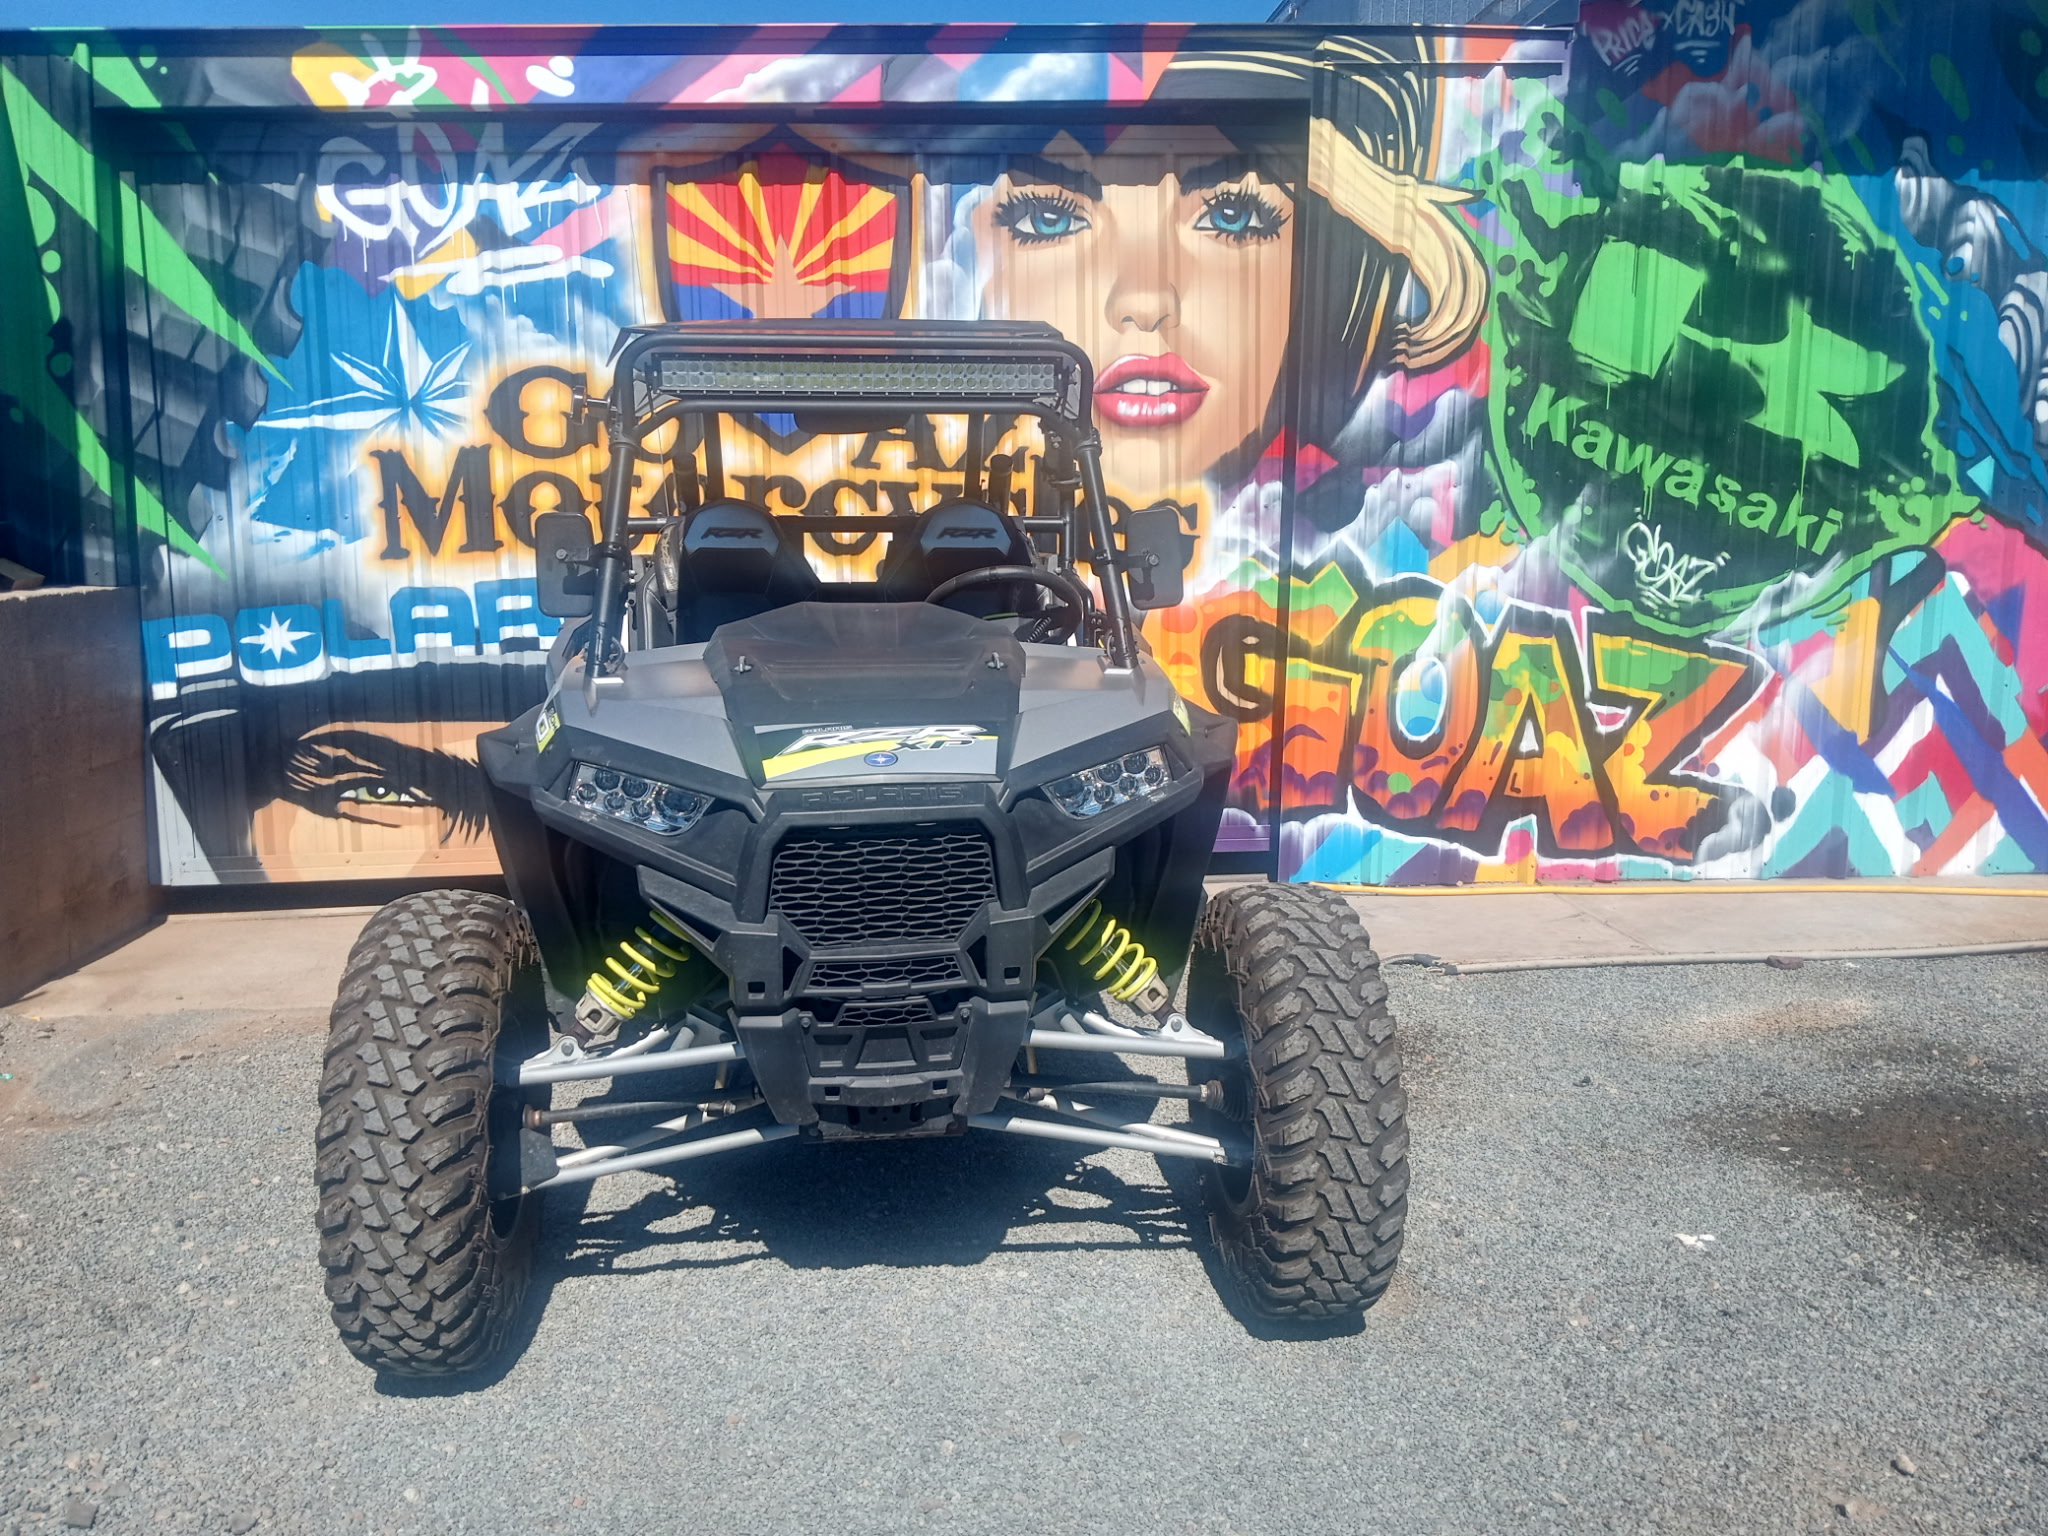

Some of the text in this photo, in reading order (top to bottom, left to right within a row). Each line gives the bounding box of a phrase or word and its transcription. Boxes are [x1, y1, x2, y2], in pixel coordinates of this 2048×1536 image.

[1522, 382, 1844, 556] Kawasaki
[774, 724, 988, 758] RZR
[893, 738, 976, 752] XP
[802, 786, 966, 807] POLARIS
